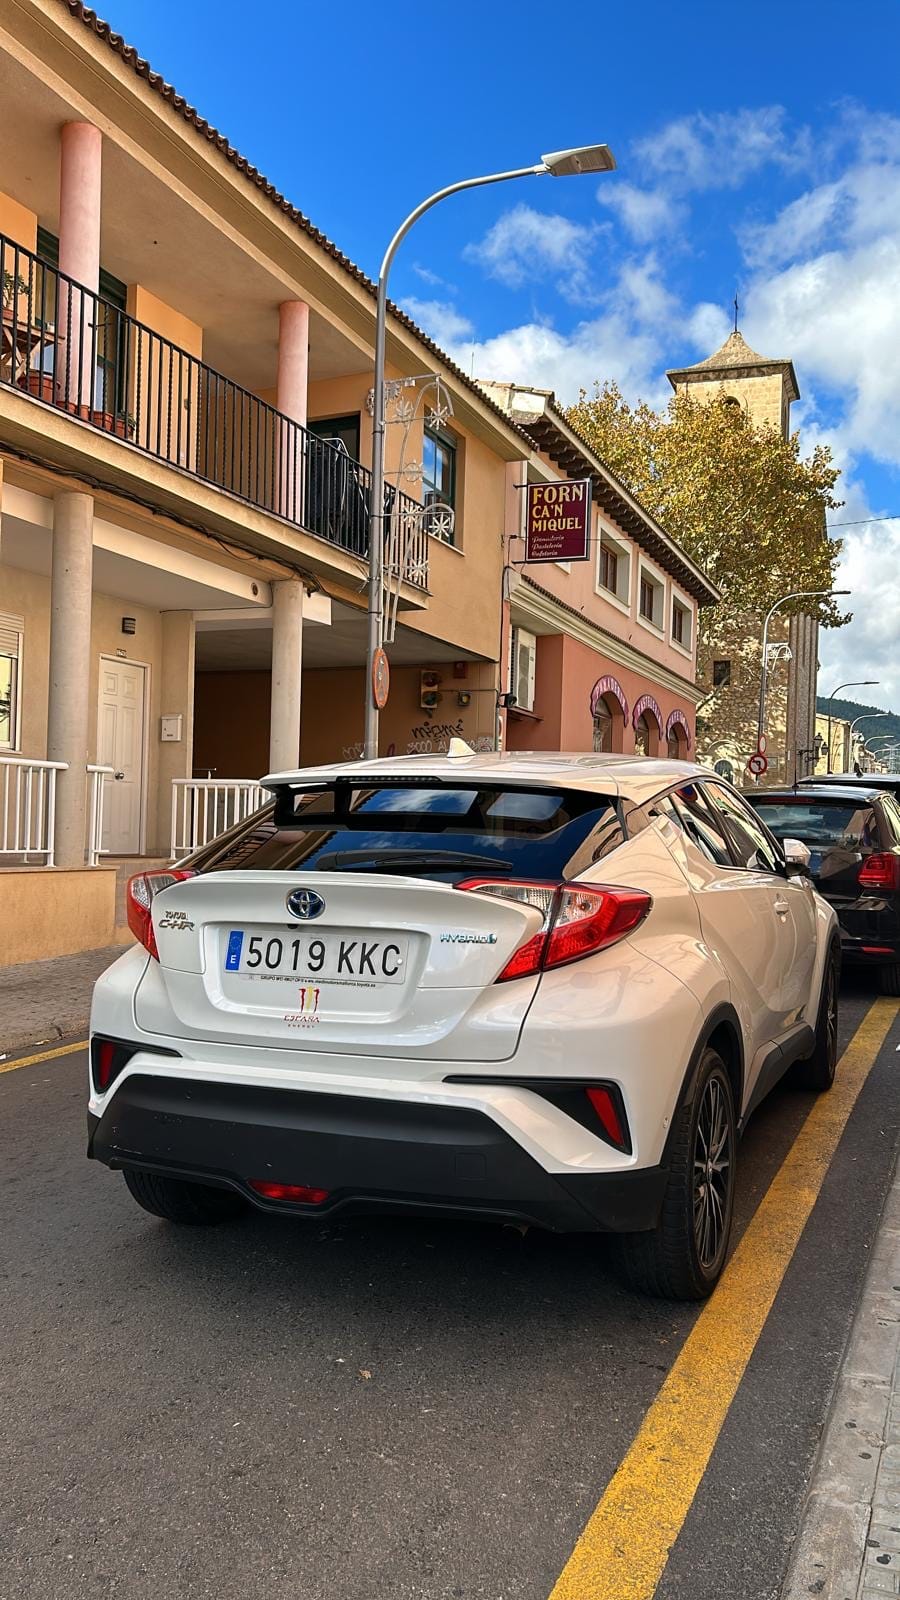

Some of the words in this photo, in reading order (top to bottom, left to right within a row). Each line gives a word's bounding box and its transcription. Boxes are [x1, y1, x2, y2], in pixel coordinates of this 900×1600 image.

[532, 484, 584, 504] FORN
[532, 503, 563, 518] CA'N
[532, 517, 582, 532] MIQUEL
[440, 933, 489, 944] HYBRID
[230, 954, 237, 964] E
[246, 936, 326, 972] 5019
[337, 941, 401, 977] KKC
